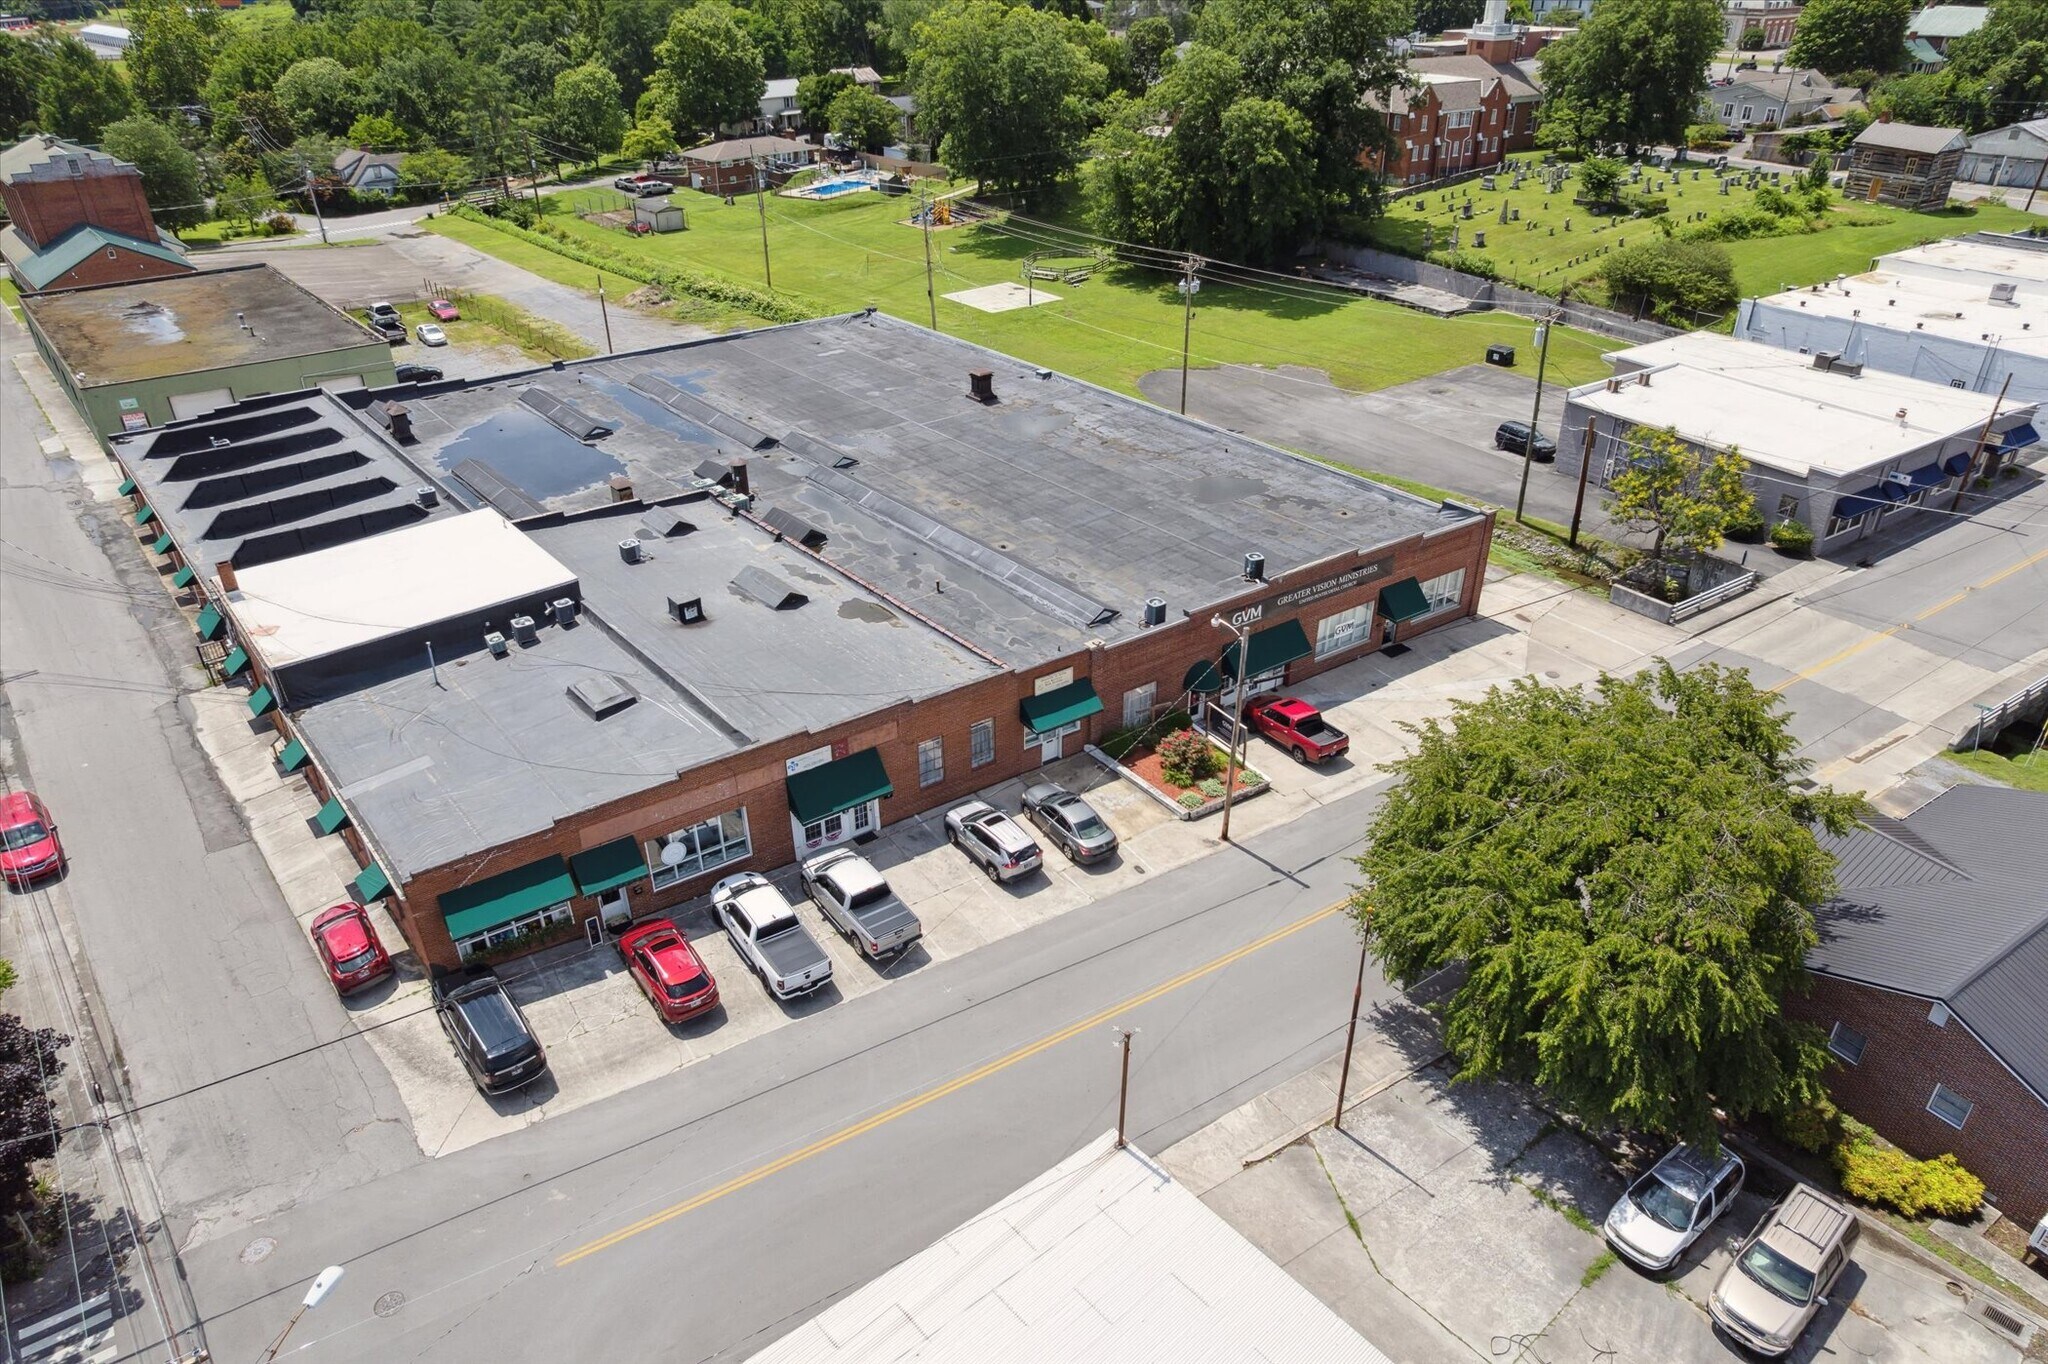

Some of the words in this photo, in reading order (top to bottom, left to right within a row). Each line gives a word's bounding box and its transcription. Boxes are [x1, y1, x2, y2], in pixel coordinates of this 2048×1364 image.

[1277, 587, 1312, 606] GREATER
[1312, 578, 1338, 593] VISION
[1338, 564, 1378, 584] MINISTRIES
[1232, 604, 1262, 625] GVM
[1335, 622, 1354, 635] GVM
